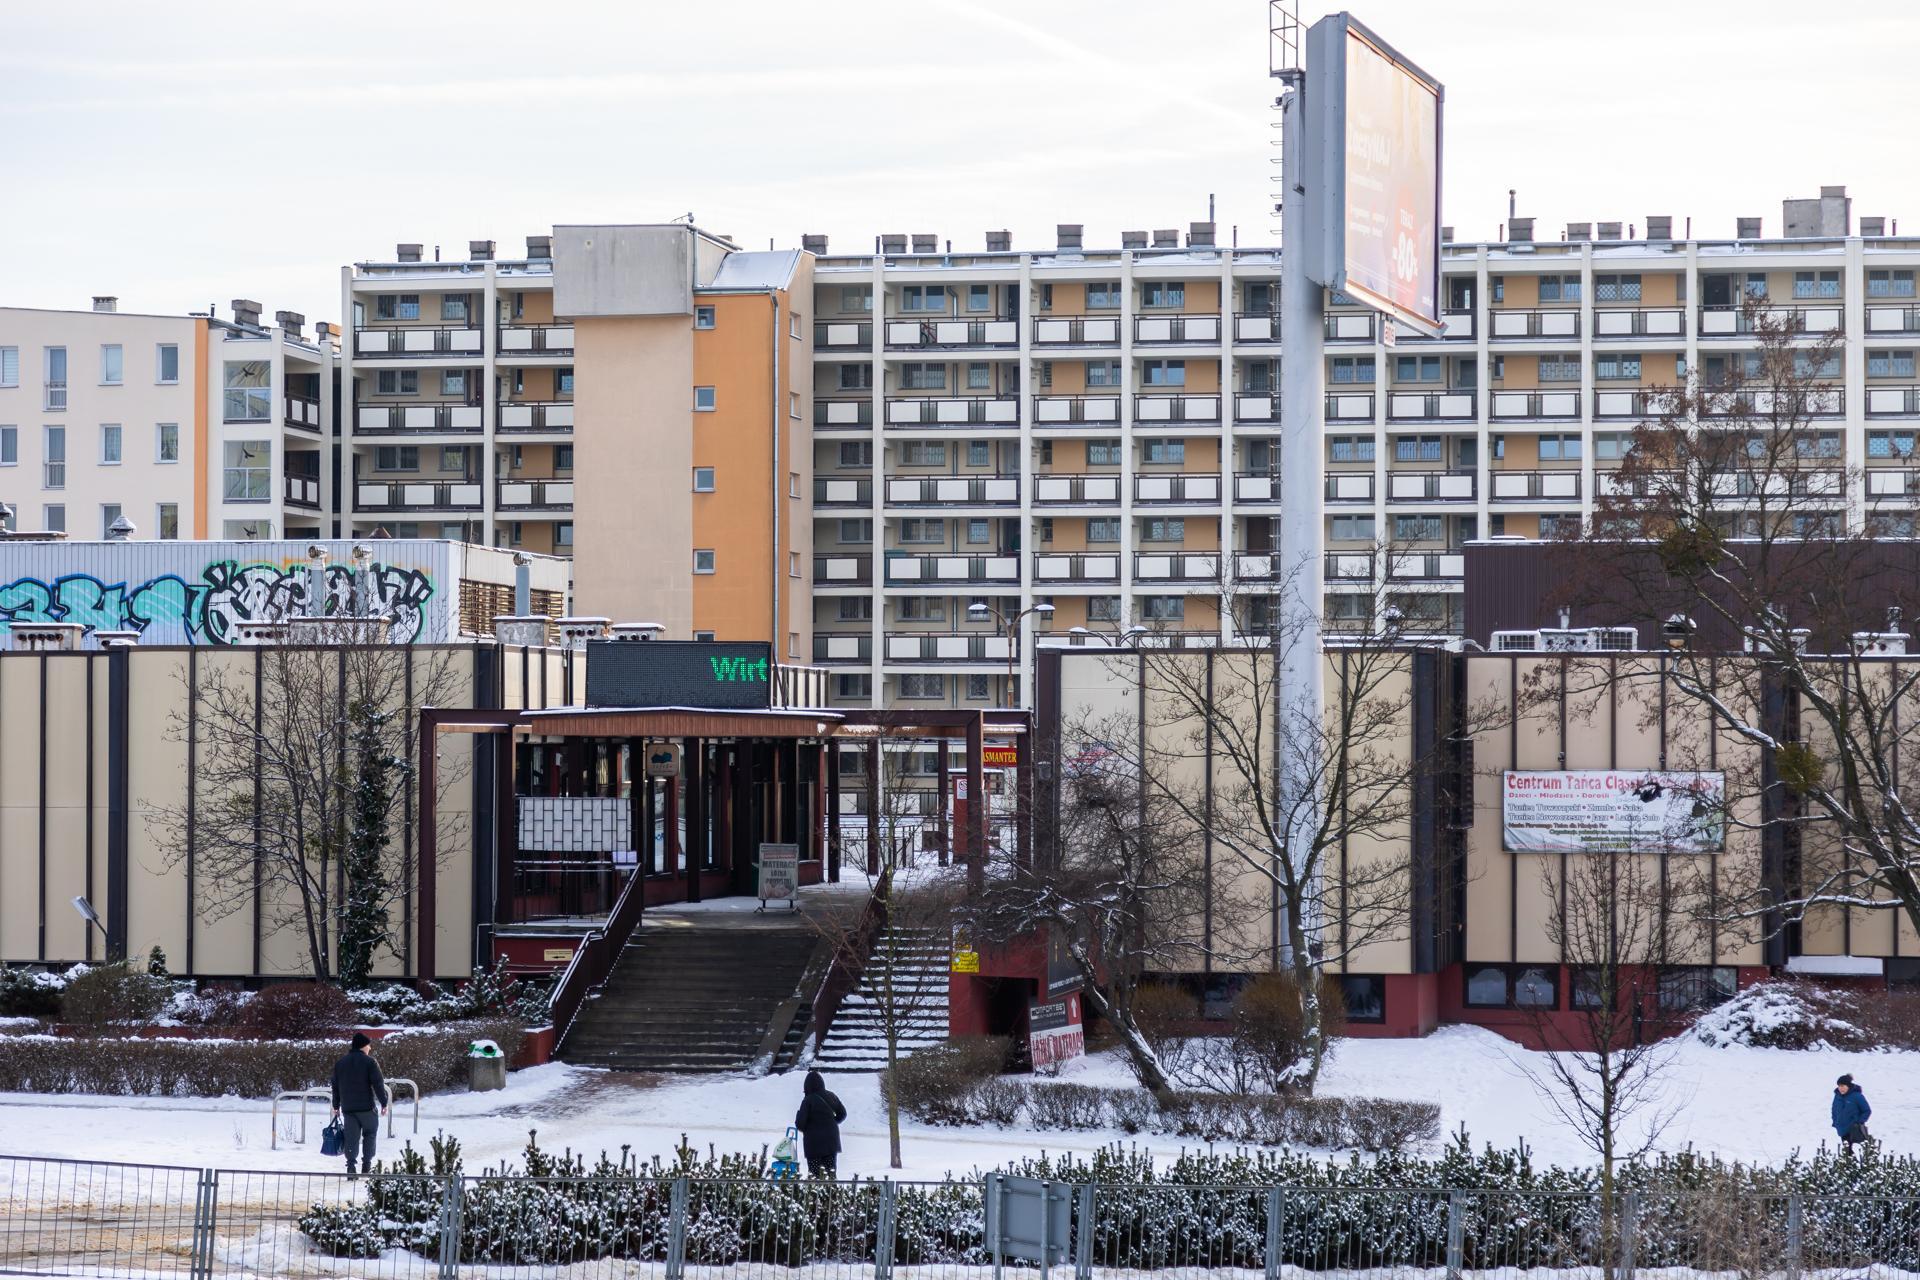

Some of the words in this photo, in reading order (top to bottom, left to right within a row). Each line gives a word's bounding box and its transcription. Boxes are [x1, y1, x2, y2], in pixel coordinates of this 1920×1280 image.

[710, 656, 768, 682] Wirt
[1508, 773, 1562, 790] Centrum
[1567, 774, 1602, 790] Tańca
[1508, 803, 1535, 811] Taniec
[1587, 803, 1617, 811] Zumba
[1622, 803, 1644, 811] Salsa
[1508, 813, 1536, 821] Taniec
[762, 860, 796, 868] MATERACE
